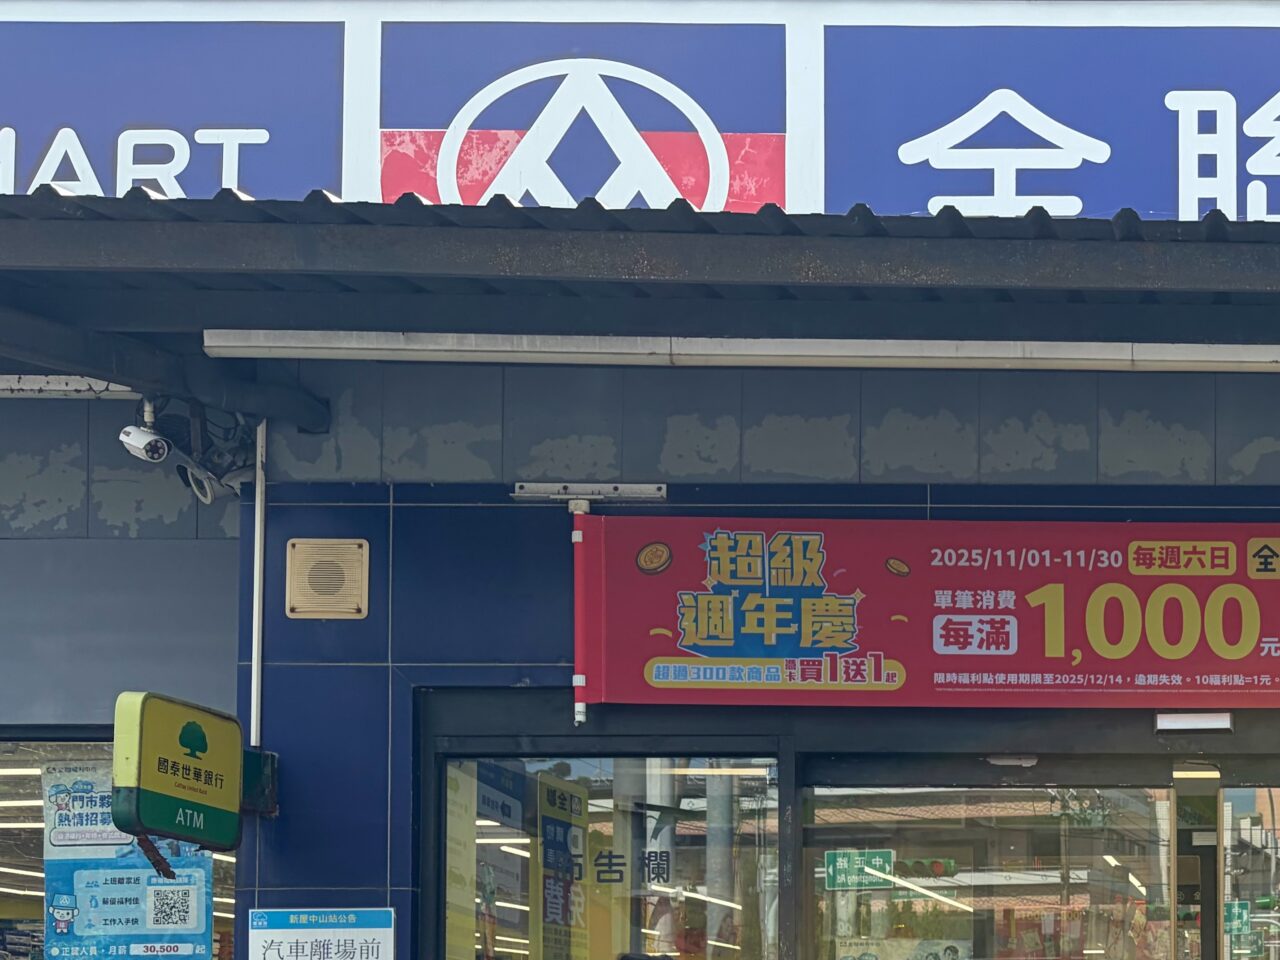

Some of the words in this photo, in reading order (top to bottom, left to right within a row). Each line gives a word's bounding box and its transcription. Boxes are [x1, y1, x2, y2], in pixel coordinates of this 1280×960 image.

[0, 127, 270, 200] ART
[708, 531, 826, 588] 超級
[930, 548, 1124, 571] 2025/11/01-11/30
[1132, 546, 1231, 570] 每週六日
[933, 590, 1017, 611] 單筆消費
[679, 592, 858, 649] 週年慶
[939, 618, 1012, 651] 每滿
[653, 664, 781, 683] 超過300款商品
[157, 756, 225, 790] 國泰世華銀行
[175, 807, 204, 830] ATM
[142, 945, 179, 955] 30,500
